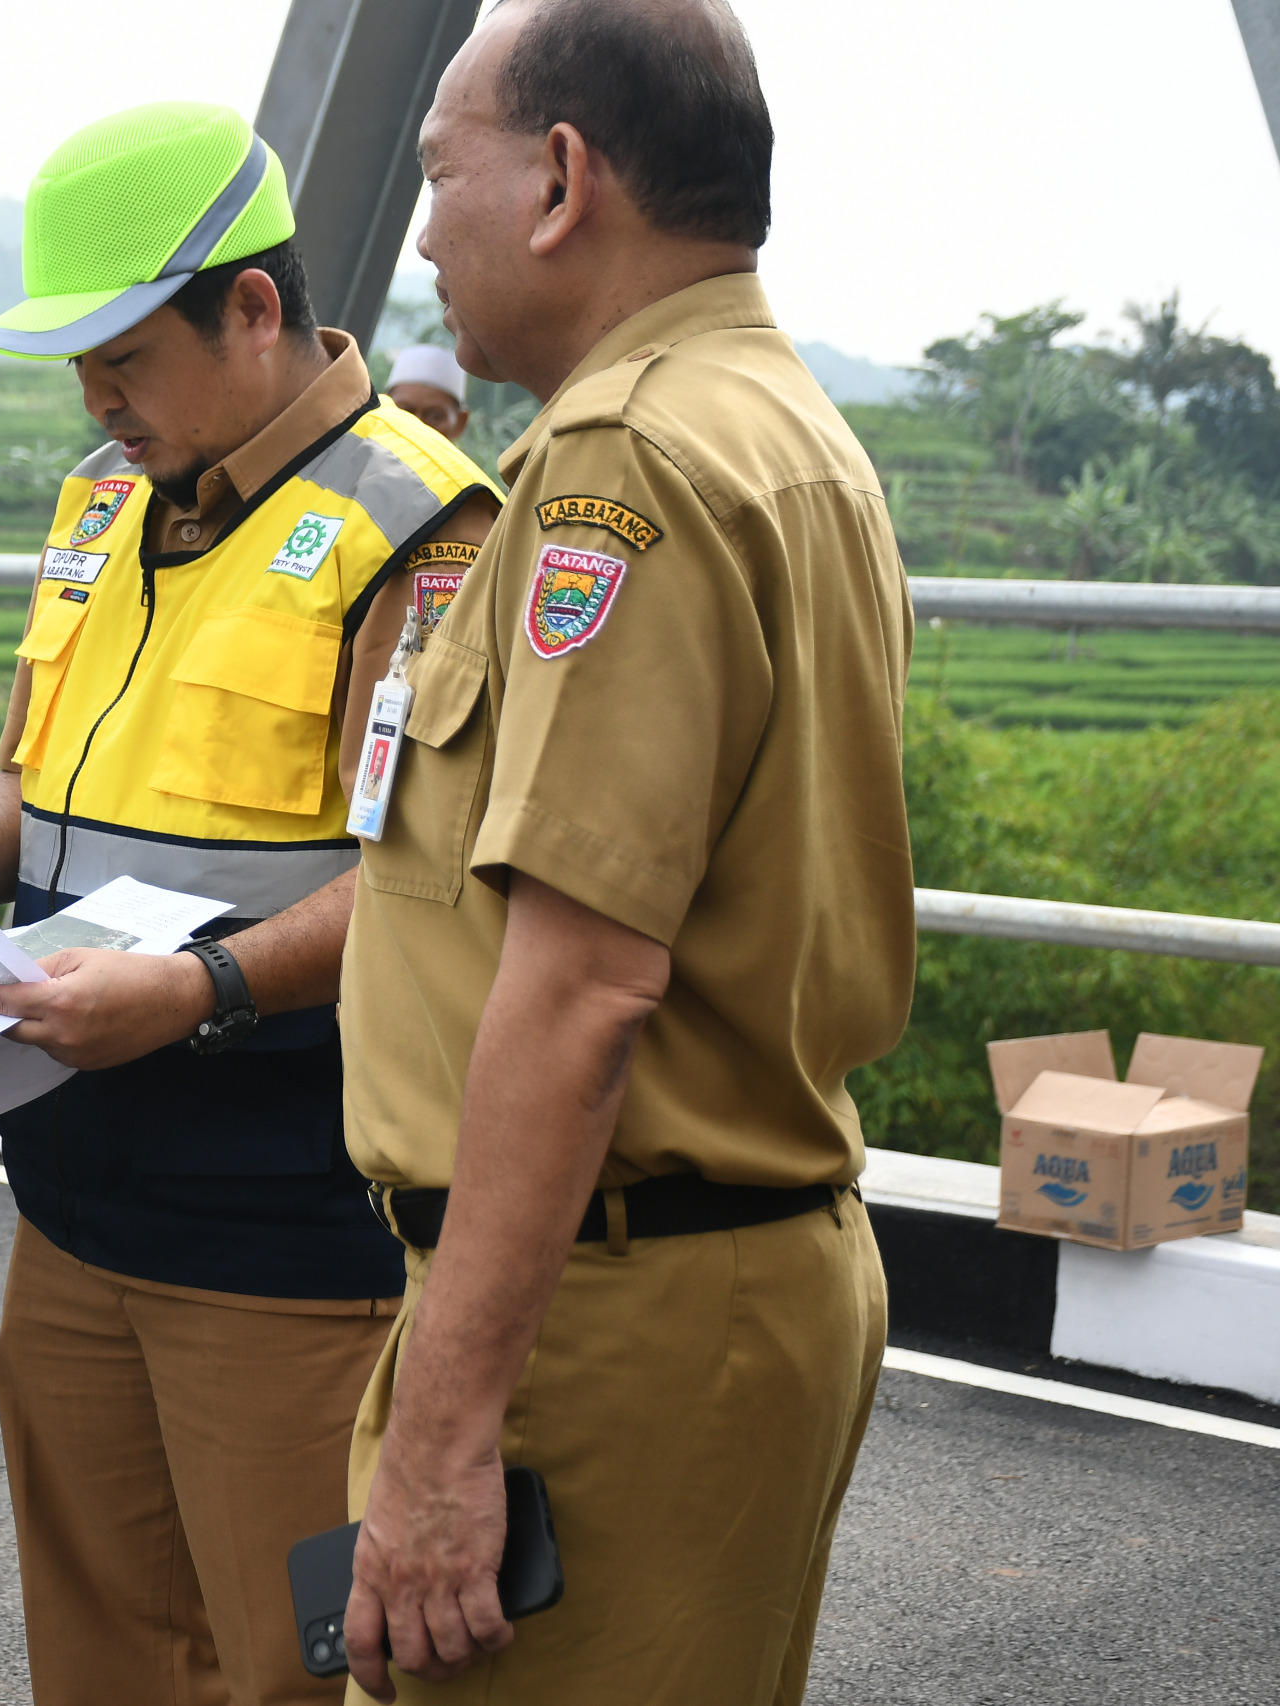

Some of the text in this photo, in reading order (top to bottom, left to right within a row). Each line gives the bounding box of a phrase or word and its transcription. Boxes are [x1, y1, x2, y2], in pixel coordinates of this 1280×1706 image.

[53, 552, 87, 567] DPUPR
[291, 563, 313, 573] FIRST
[548, 552, 618, 576] BATANG
[1032, 1153, 1091, 1184] AQUA
